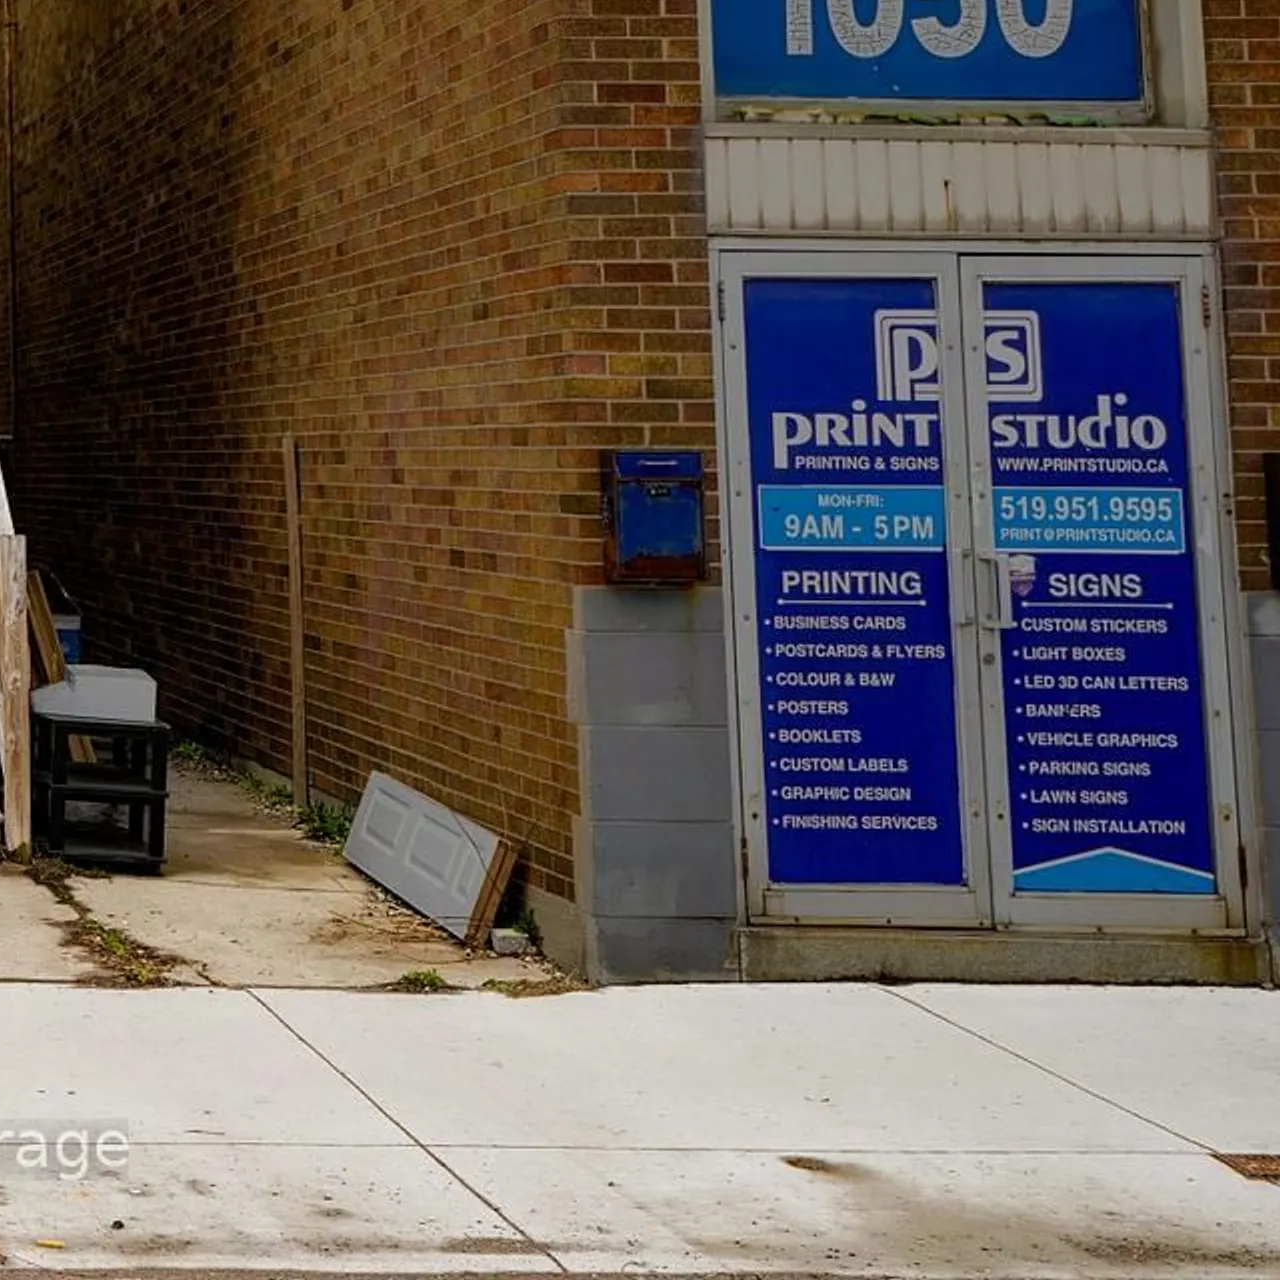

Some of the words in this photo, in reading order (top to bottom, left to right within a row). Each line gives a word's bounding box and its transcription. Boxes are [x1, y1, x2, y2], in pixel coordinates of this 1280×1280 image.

[795, 455, 870, 470] PRINTING
[874, 456, 886, 470] &
[890, 456, 940, 470] SIGNS
[997, 457, 1169, 473] WWW.PRINTSTUDIO.CA
[817, 493, 884, 509] MON-FRI:
[1000, 496, 1172, 521] 519.951.9595
[784, 514, 843, 540] 9AM
[1000, 527, 1176, 543] PRINT@PRINTSTUDIO.CA
[782, 571, 922, 595] PRINTING
[1048, 573, 1142, 598] SIGNS
[774, 616, 849, 630] BUSINESS
[853, 616, 906, 630] CARDS
[1021, 619, 1087, 632] CUSTOM
[1091, 620, 1168, 633] STICKERS
[775, 644, 867, 658] POSTCARDS
[872, 644, 883, 658] &
[887, 645, 945, 659] FLYERS
[1022, 647, 1068, 661] LIGHT
[1072, 648, 1126, 662] BOXES
[776, 673, 841, 686] COLOUR
[844, 673, 855, 686] &
[859, 673, 895, 686] B&W
[1024, 675, 1055, 689] LED
[1058, 676, 1079, 690] 3D
[1082, 676, 1115, 690] CAN
[1119, 677, 1189, 691] LETTERS
[777, 701, 849, 714] POSTERS
[778, 729, 862, 743] BOOKLETS
[1027, 732, 1093, 747] VEHICLE
[1097, 733, 1178, 748] GRAPHICS
[780, 758, 844, 772] CUSTOM
[848, 758, 908, 772] LABELS
[1029, 761, 1099, 775] PARKING
[1103, 762, 1151, 776] SIGNS
[781, 786, 849, 800] GRAPHIC
[854, 787, 911, 801] DESIGN
[1031, 790, 1076, 804] LAWN
[1080, 791, 1128, 805] SIGNS
[782, 815, 858, 829] FINISHING
[862, 816, 938, 830] SERVICES
[1032, 819, 1070, 833] SIGN
[1074, 820, 1186, 834] INSTALLATION
